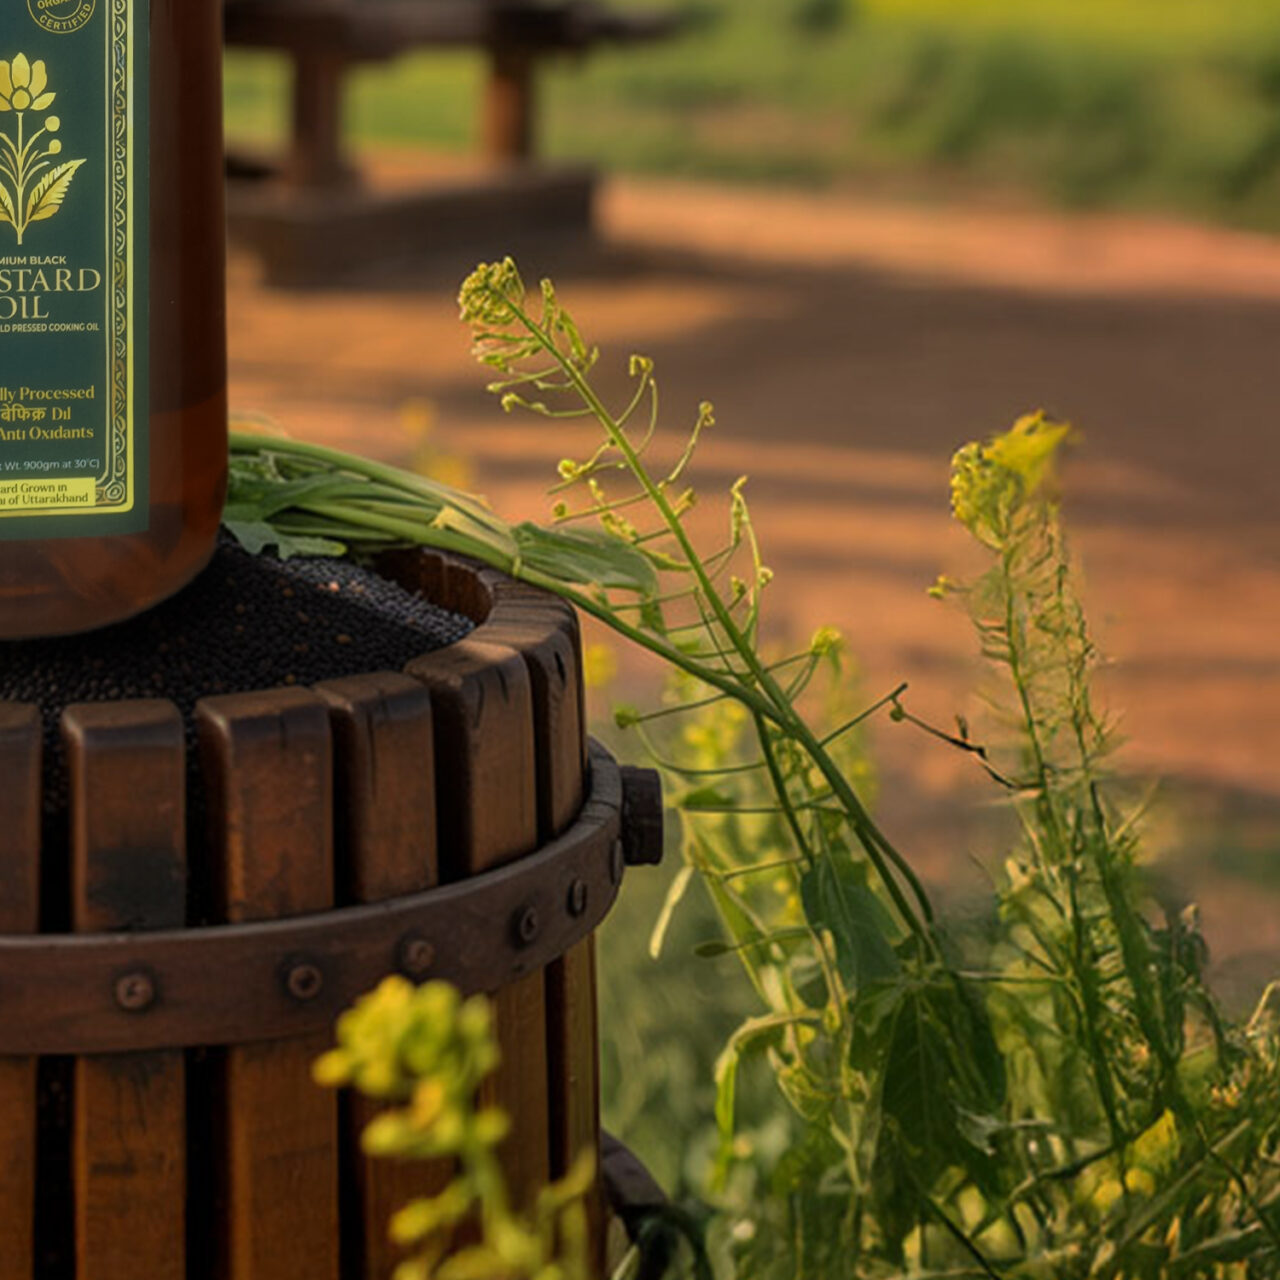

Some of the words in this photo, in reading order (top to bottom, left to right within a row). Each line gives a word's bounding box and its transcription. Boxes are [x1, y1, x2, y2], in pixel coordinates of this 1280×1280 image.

[39, 3, 91, 30] CERTIFIED
[29, 256, 67, 265] BLACK
[12, 323, 47, 332] PRESSED
[48, 323, 85, 332] COOKING
[86, 322, 100, 331] OIL
[20, 385, 95, 401] Processed
[29, 426, 94, 440] Oxidants
[4, 461, 21, 471] Wt.
[23, 460, 60, 473] 900gm
[62, 460, 72, 469] at
[20, 484, 55, 494] Grown
[58, 483, 67, 492] in
[8, 495, 20, 505] of
[22, 494, 89, 505] Uttarakhand
